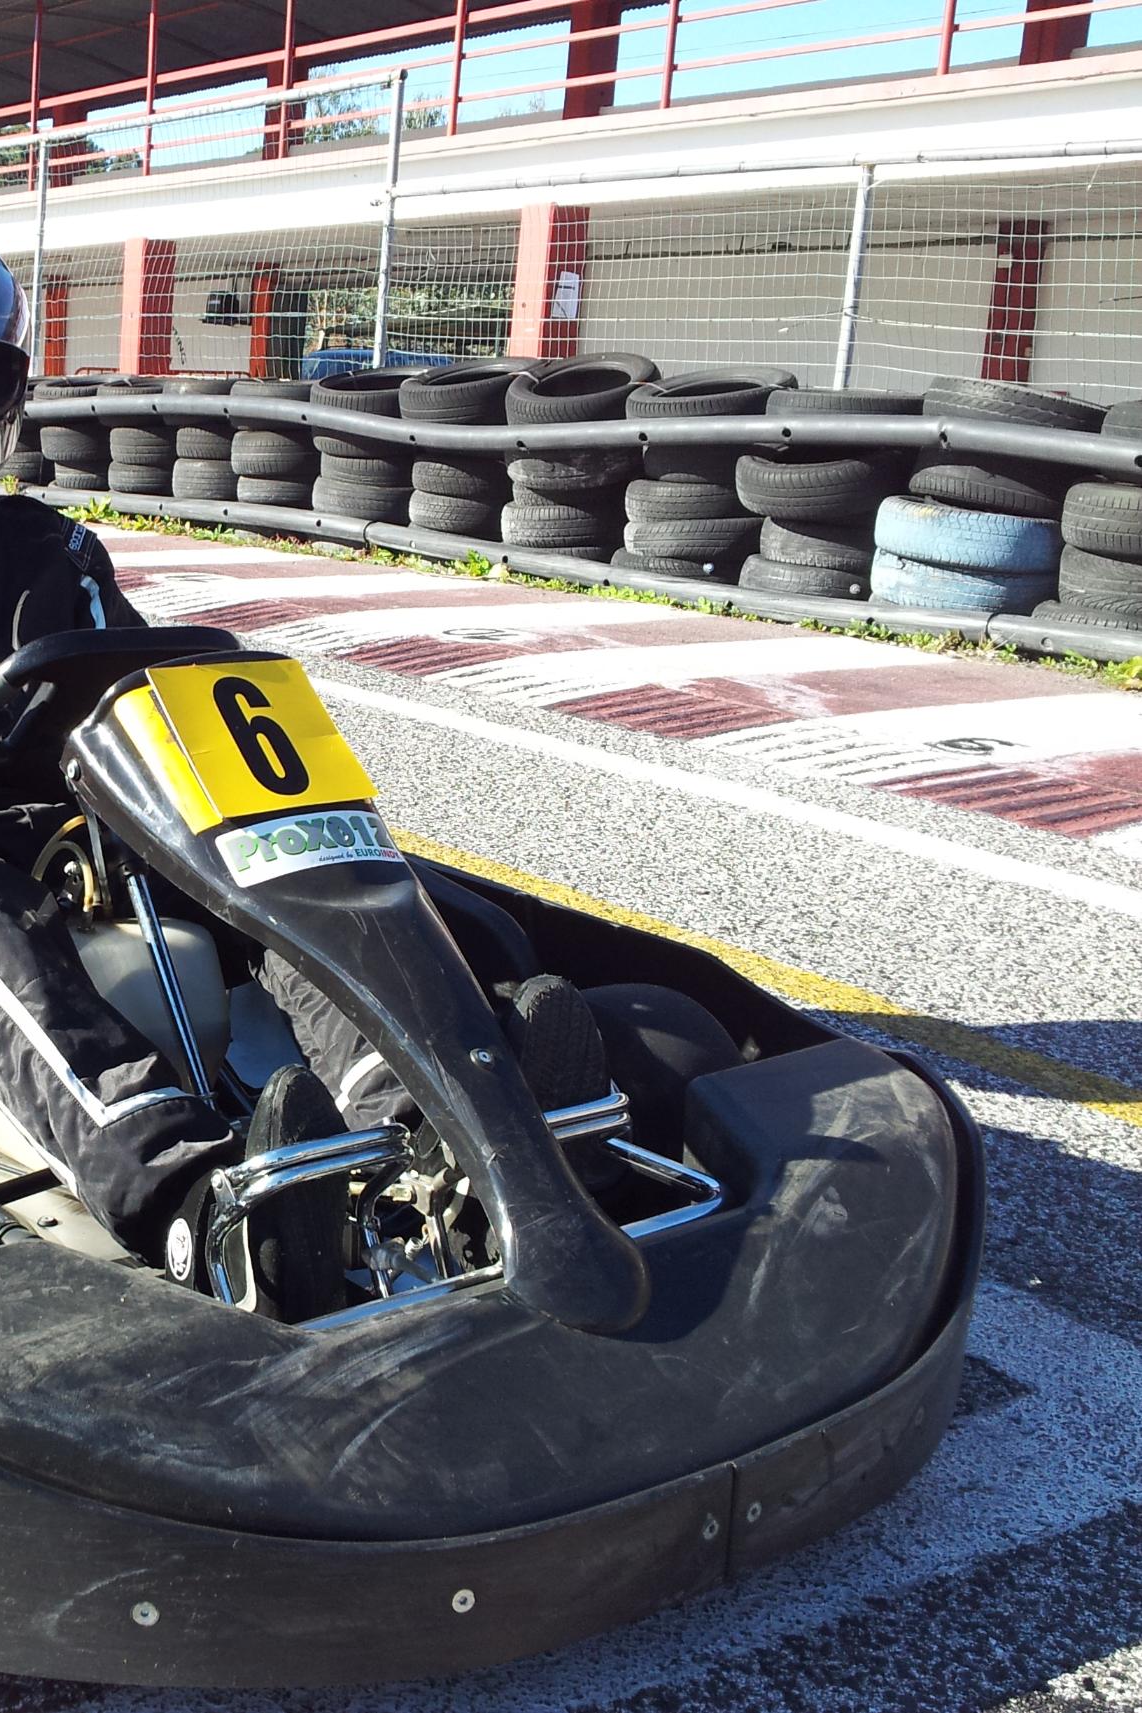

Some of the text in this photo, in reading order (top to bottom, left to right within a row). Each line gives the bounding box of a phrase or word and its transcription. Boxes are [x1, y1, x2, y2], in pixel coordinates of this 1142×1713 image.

[212, 676, 310, 797] 6
[318, 853, 345, 862] designed
[354, 848, 401, 859] EUROINDY
